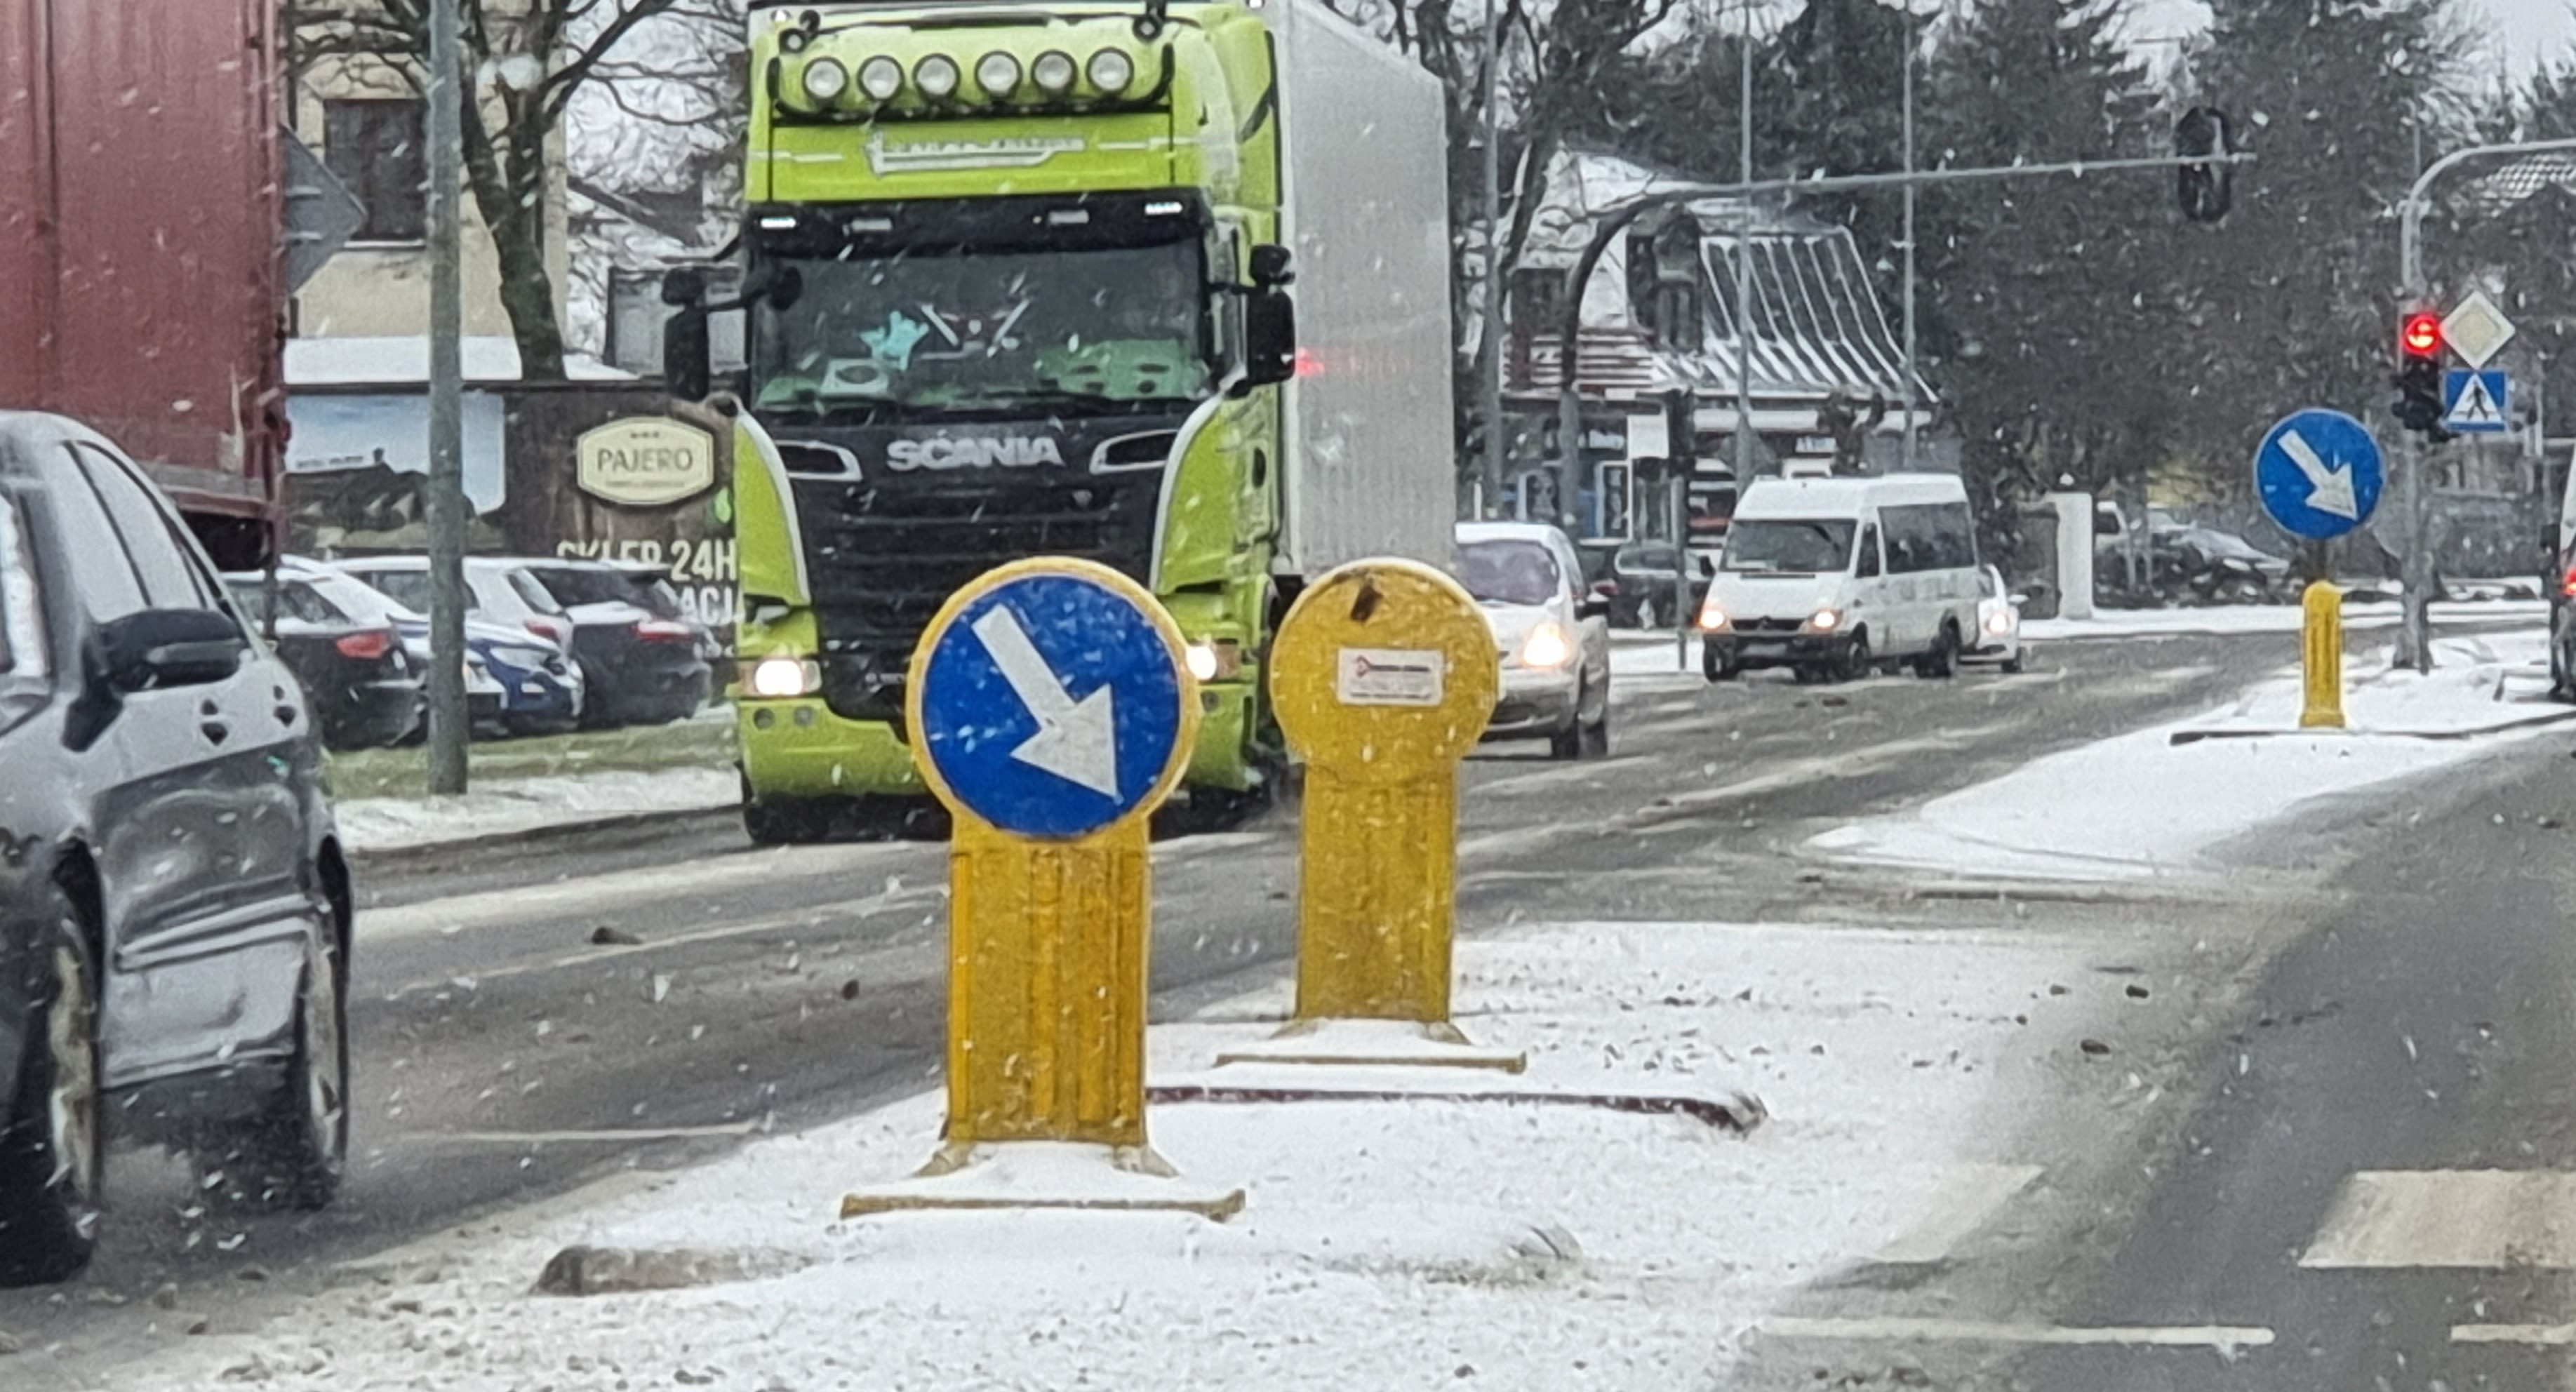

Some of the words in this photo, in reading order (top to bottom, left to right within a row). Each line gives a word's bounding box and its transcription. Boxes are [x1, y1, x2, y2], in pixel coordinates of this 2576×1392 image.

[598, 448, 693, 473] PAJERO
[887, 436, 1065, 471] SCANIA
[670, 538, 736, 582] 24H
